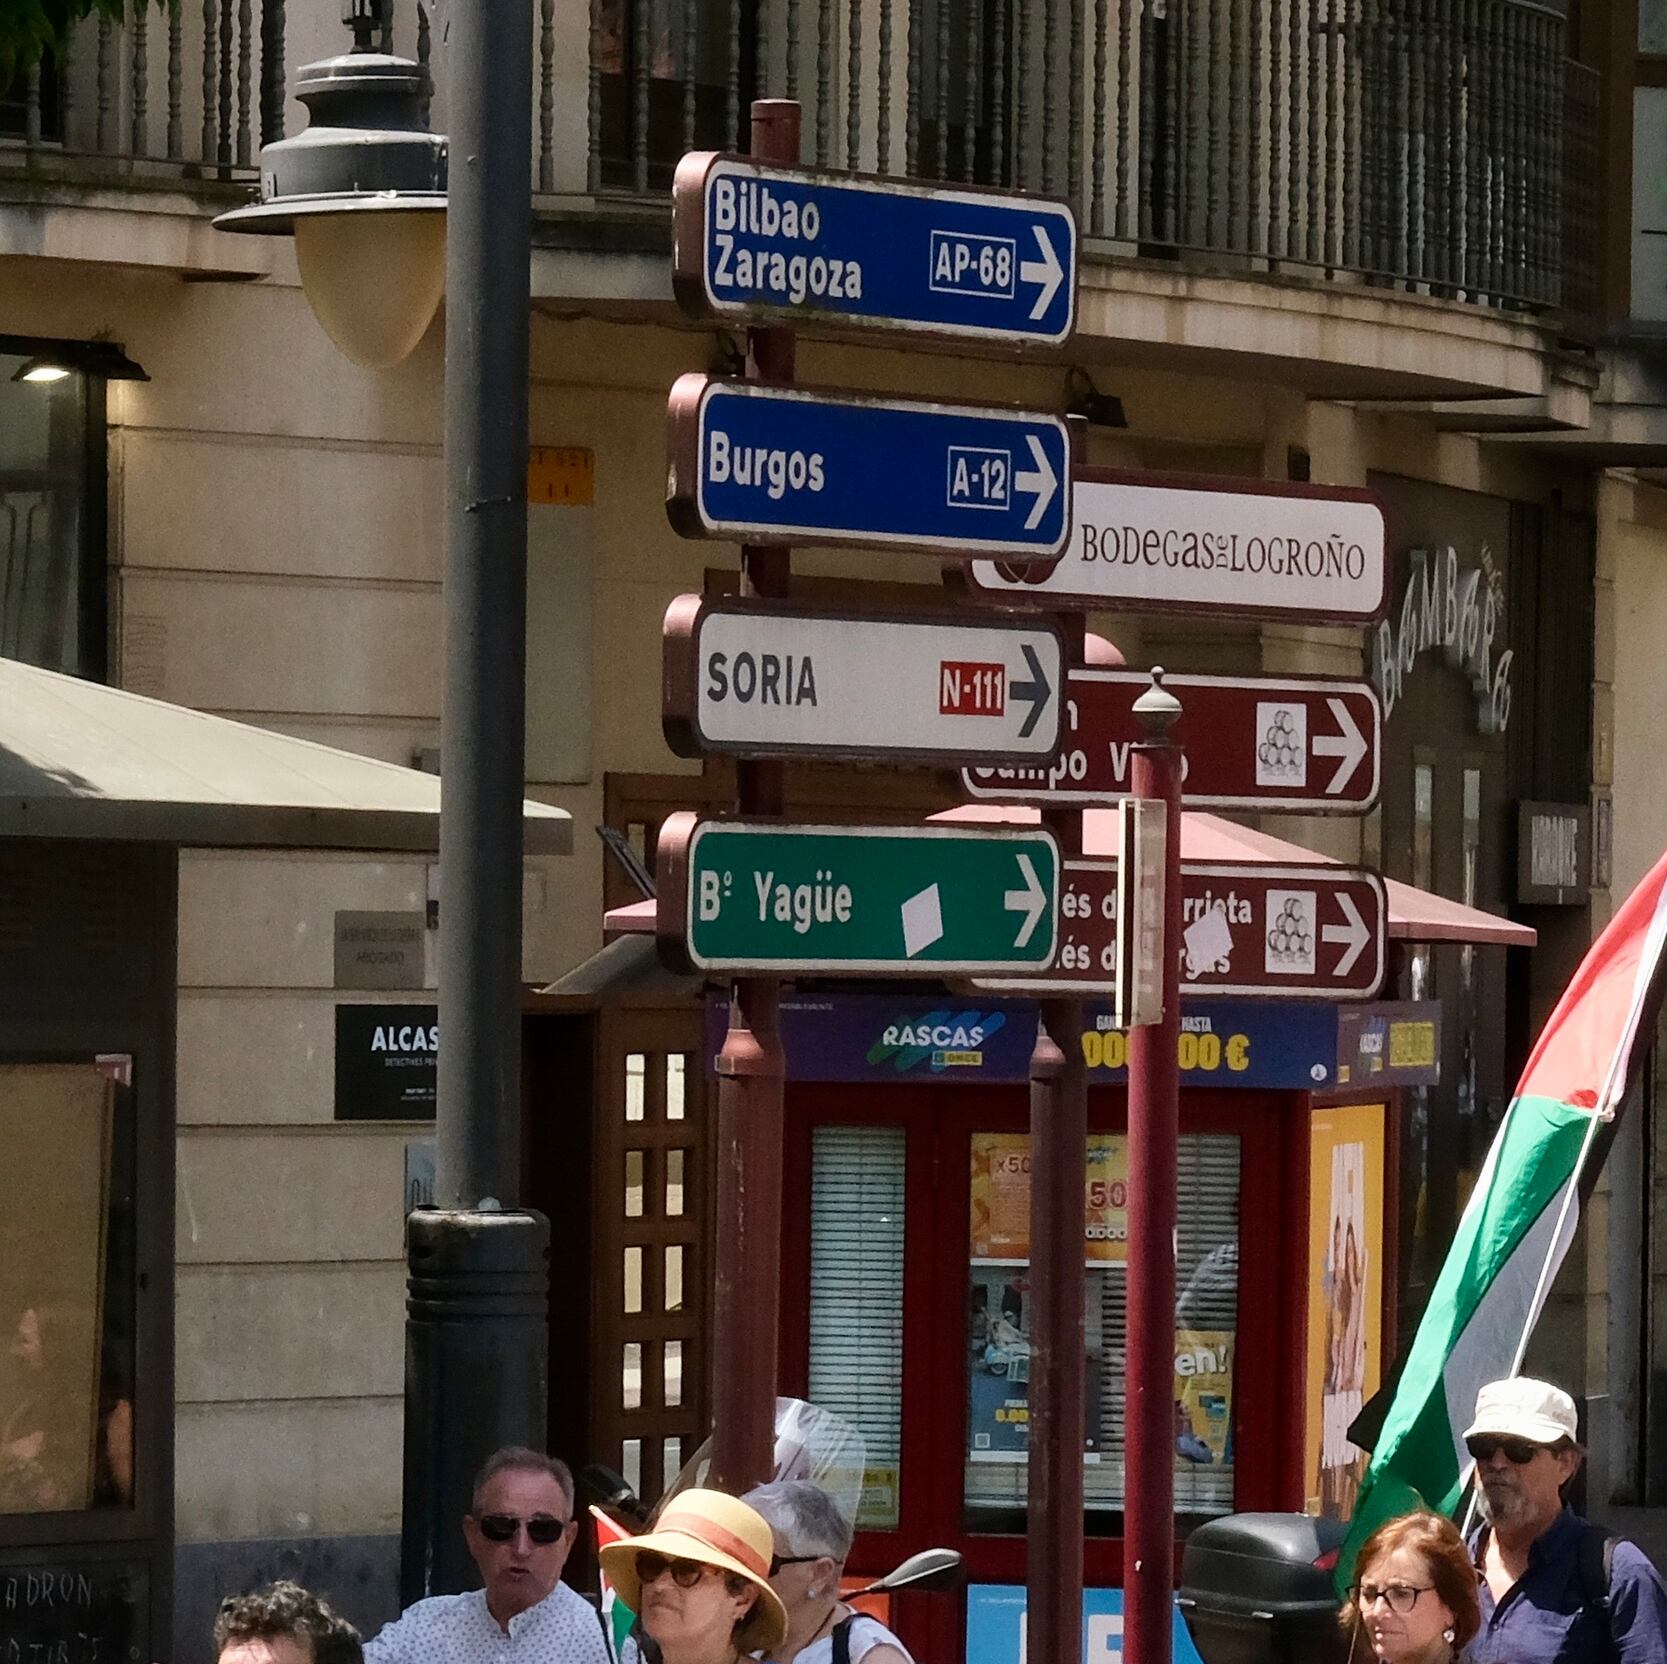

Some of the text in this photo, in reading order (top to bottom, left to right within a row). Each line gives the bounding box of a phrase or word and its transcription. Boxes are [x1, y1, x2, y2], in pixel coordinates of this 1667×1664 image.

[714, 180, 820, 240] Bilbao
[714, 234, 863, 304] Zaragoza
[934, 240, 1011, 289] AP-68
[709, 431, 826, 500] Burgos
[951, 453, 1007, 501] A-12
[1230, 534, 1366, 580] LOGROÑO
[706, 651, 818, 708] SORIA
[942, 662, 1003, 710] N-111
[754, 867, 854, 934] Yagüe
[882, 1024, 985, 1048] RASCAS
